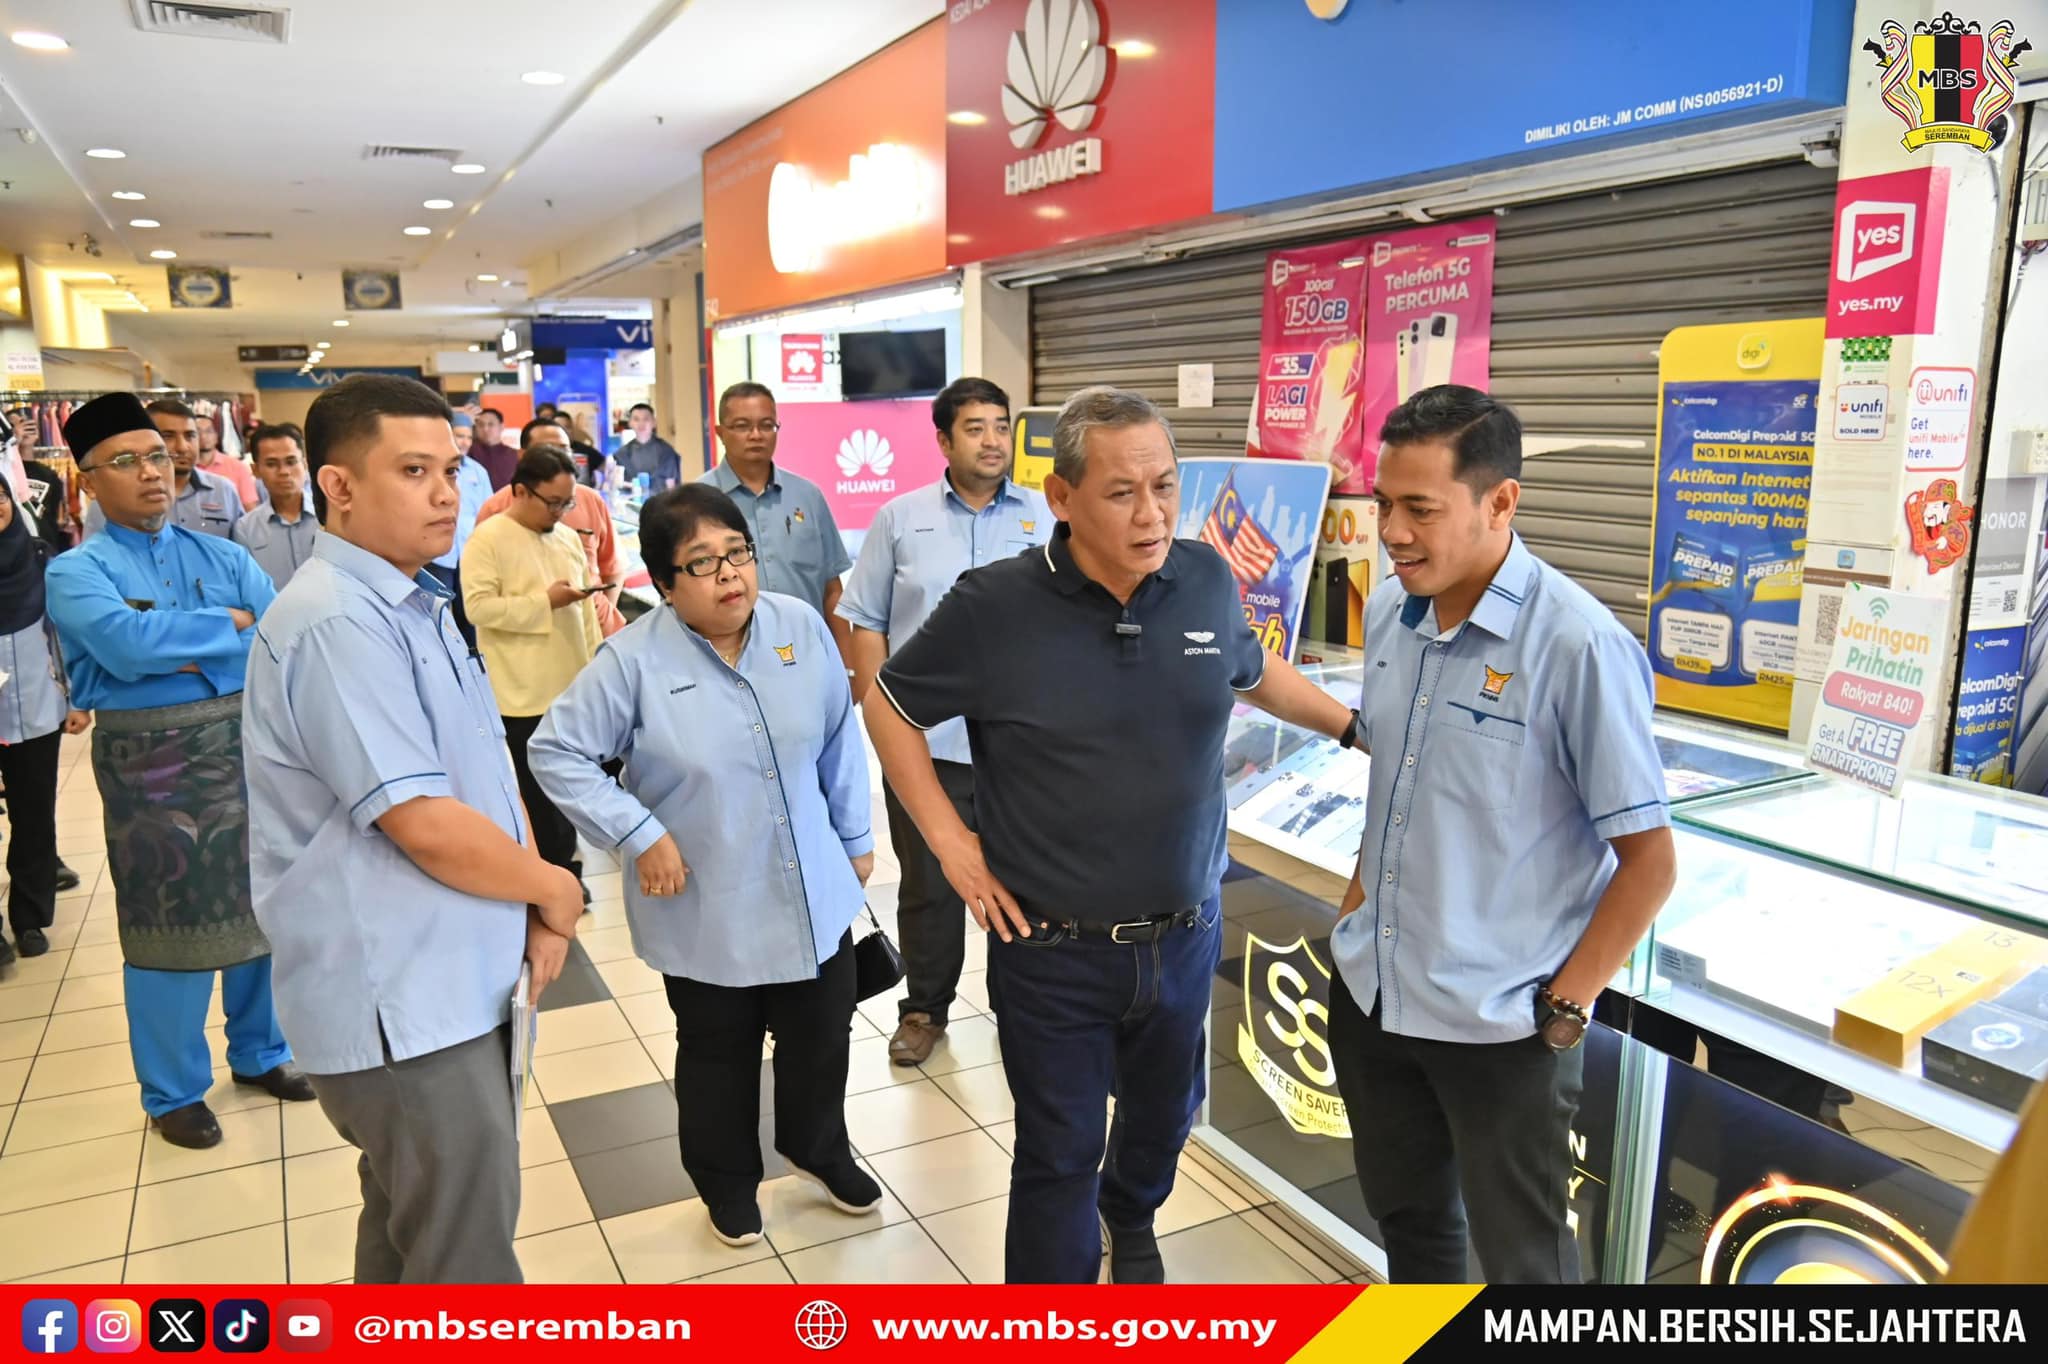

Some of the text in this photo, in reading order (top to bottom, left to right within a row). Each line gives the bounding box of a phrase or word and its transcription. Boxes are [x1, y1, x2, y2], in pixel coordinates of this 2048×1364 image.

[1524, 73, 1784, 144] DIMILIKI OLEH: JM COMM (NS0056921-D)
[1004, 138, 1102, 195] HUAWEI
[1857, 225, 1902, 253] yes
[1384, 256, 1471, 292] Telefon 5G
[1385, 280, 1470, 314] PERCUMA
[1838, 295, 1904, 317] yes.my
[1285, 292, 1349, 328] 150GB
[616, 320, 652, 344] vi
[1265, 384, 1308, 407] LAGI
[1851, 398, 1883, 413] unifi
[1264, 407, 1308, 422] POWER
[1911, 417, 1929, 431] Get
[1693, 429, 1751, 443] CelcomDigi
[1752, 430, 1796, 443] Prepaid
[1930, 432, 1959, 444] Mobile
[1697, 447, 1810, 462] NO. 1 DI MALAYSIA
[1908, 447, 1934, 460] here.
[836, 479, 896, 494] HUAWEI
[1668, 468, 1810, 489] Aktifkan Internet
[1675, 489, 1811, 512] sepantas 100Mb
[1685, 508, 1808, 530] sepanjang hari
[1673, 551, 1735, 575] PREPAID
[1713, 574, 1732, 588] 5G
[1247, 592, 1281, 608] mobile
[1840, 615, 1931, 655] Jaringan
[1846, 646, 1924, 687] Prihatin
[1841, 681, 1883, 706] Rakyat
[1959, 672, 2019, 694] elcomDigi
[1956, 697, 1997, 721] repaid
[1819, 717, 1905, 765] Get A FREE
[1811, 743, 1897, 790] SMARTPHONE
[1252, 1048, 1304, 1102] SCREEN
